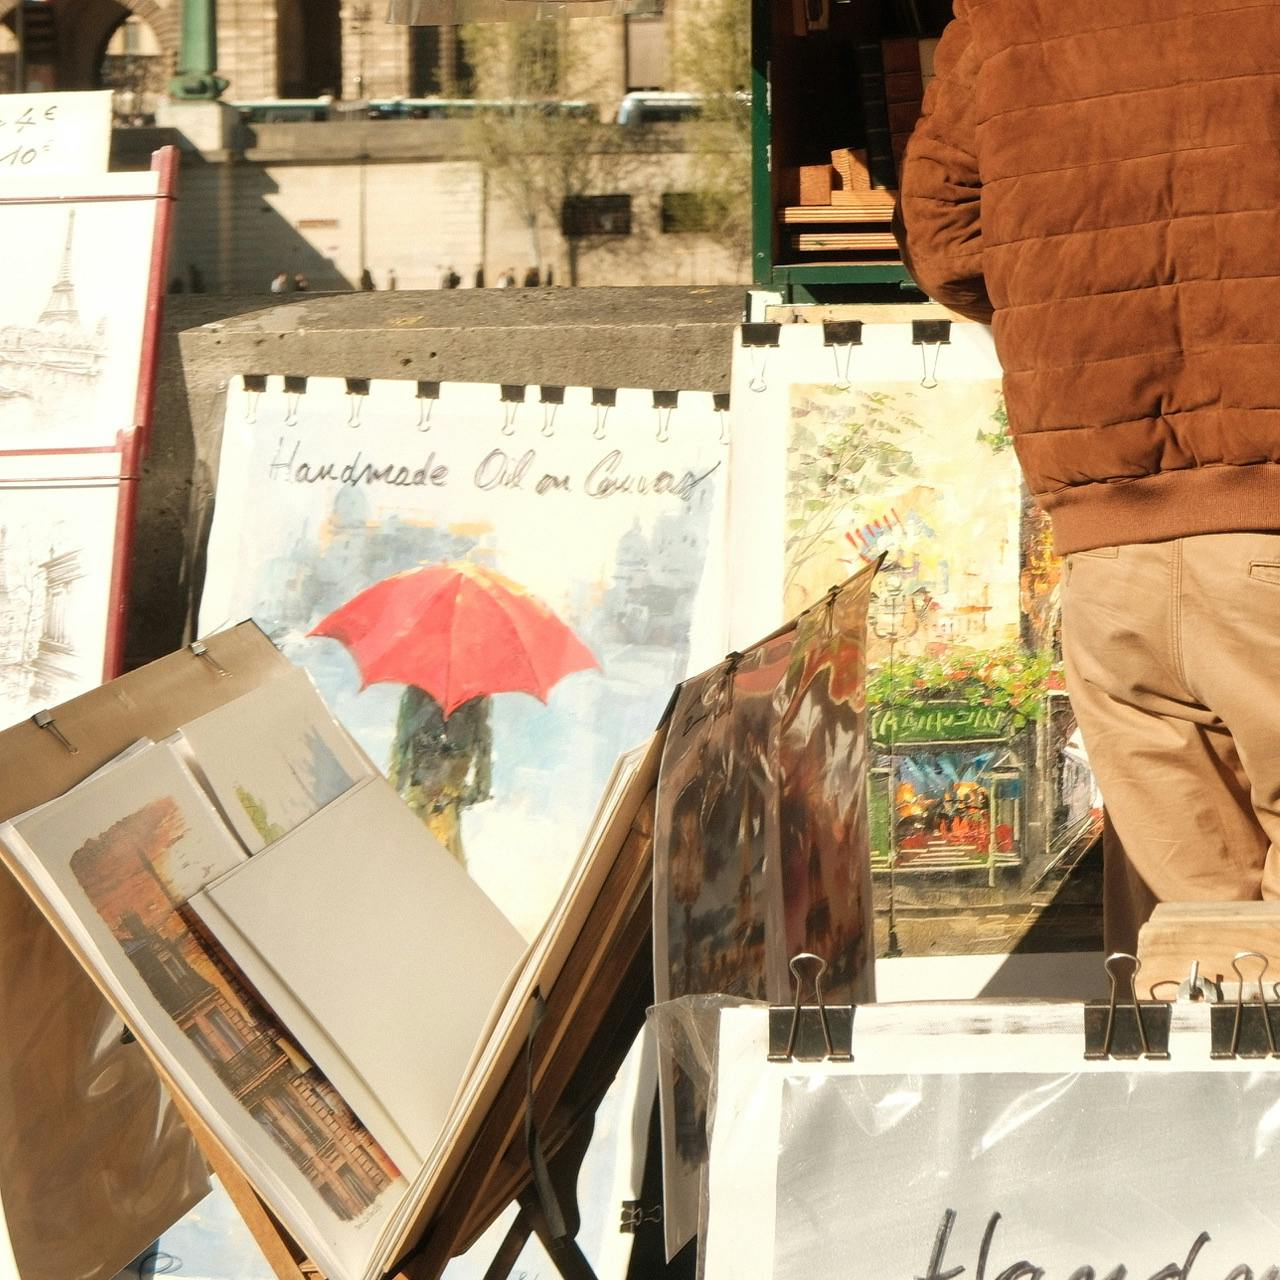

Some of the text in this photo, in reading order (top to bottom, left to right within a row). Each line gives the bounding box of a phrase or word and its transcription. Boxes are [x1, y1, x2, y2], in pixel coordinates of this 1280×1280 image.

[269, 436, 722, 502] Handmade Oil on Canvas
